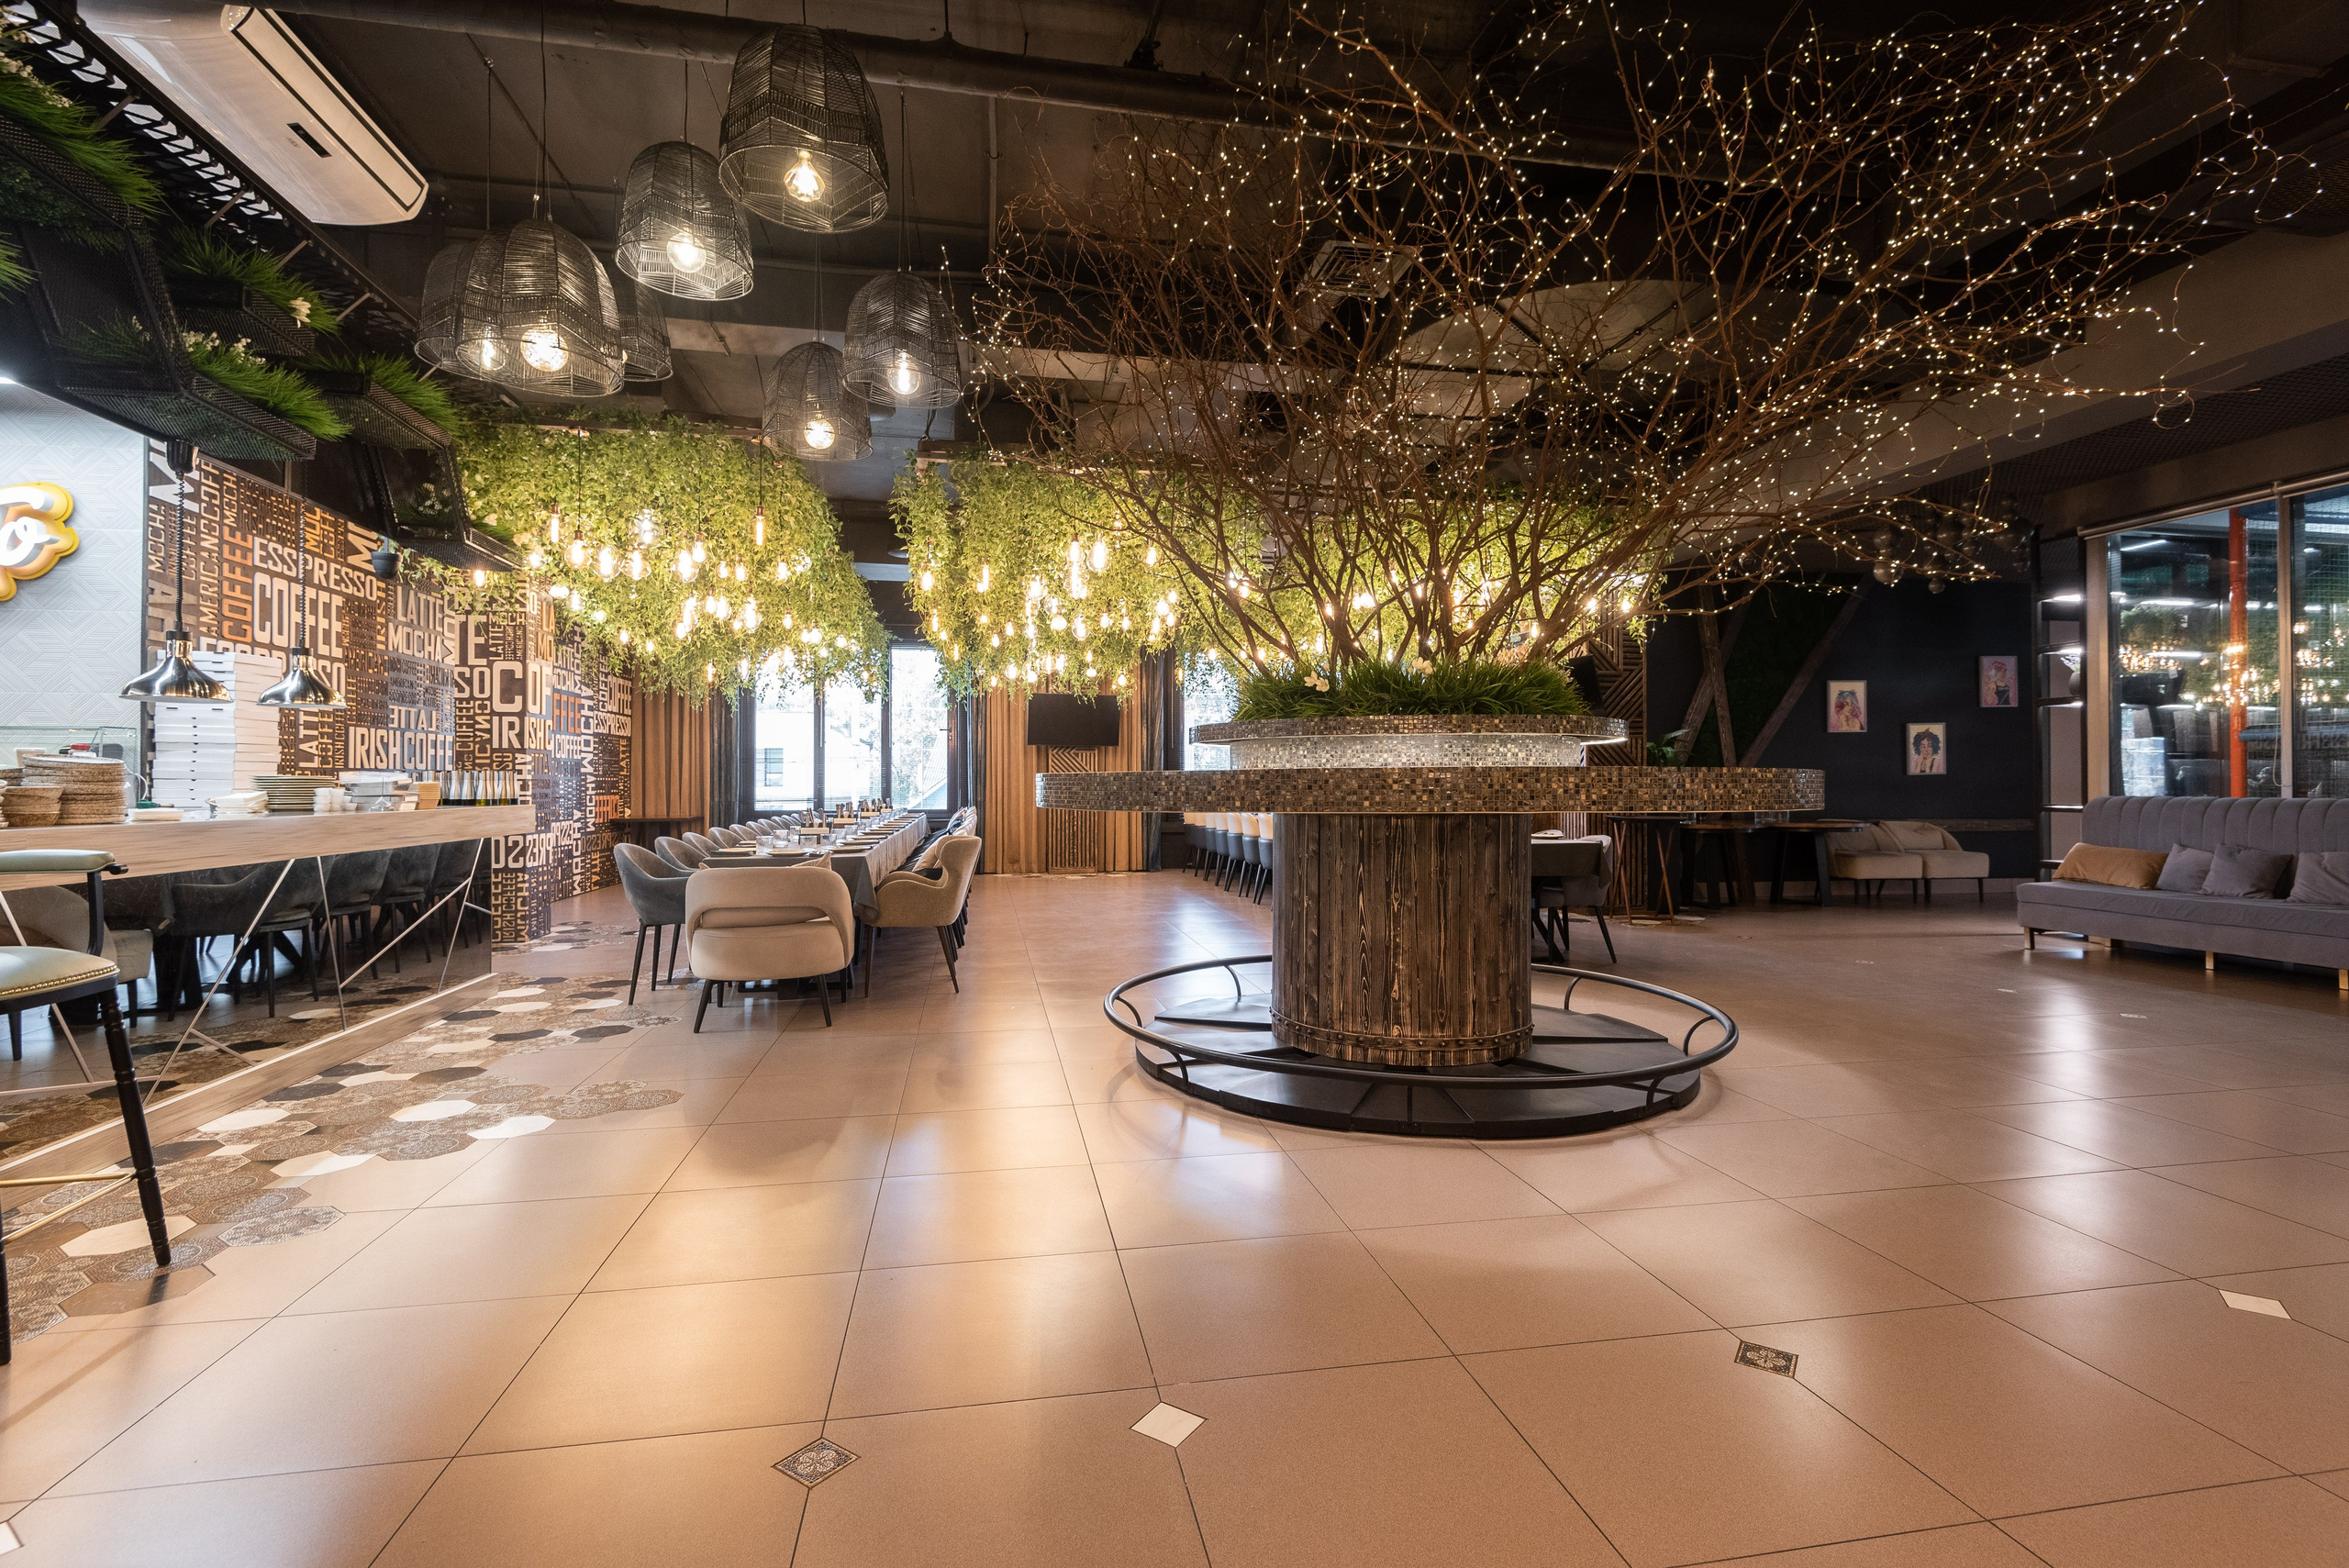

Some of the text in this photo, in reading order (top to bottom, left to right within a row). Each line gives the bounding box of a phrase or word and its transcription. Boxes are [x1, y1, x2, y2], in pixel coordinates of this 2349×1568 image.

[222, 525, 252, 642] COFFEE
[254, 537, 377, 602] ESSPRESSO
[253, 572, 343, 659] COFFEE
[396, 585, 444, 633] LATTE
[387, 622, 442, 663] MOCHA
[607, 674, 632, 716] COFFEE
[298, 708, 319, 769] LATT
[348, 726, 402, 769] IRISH
